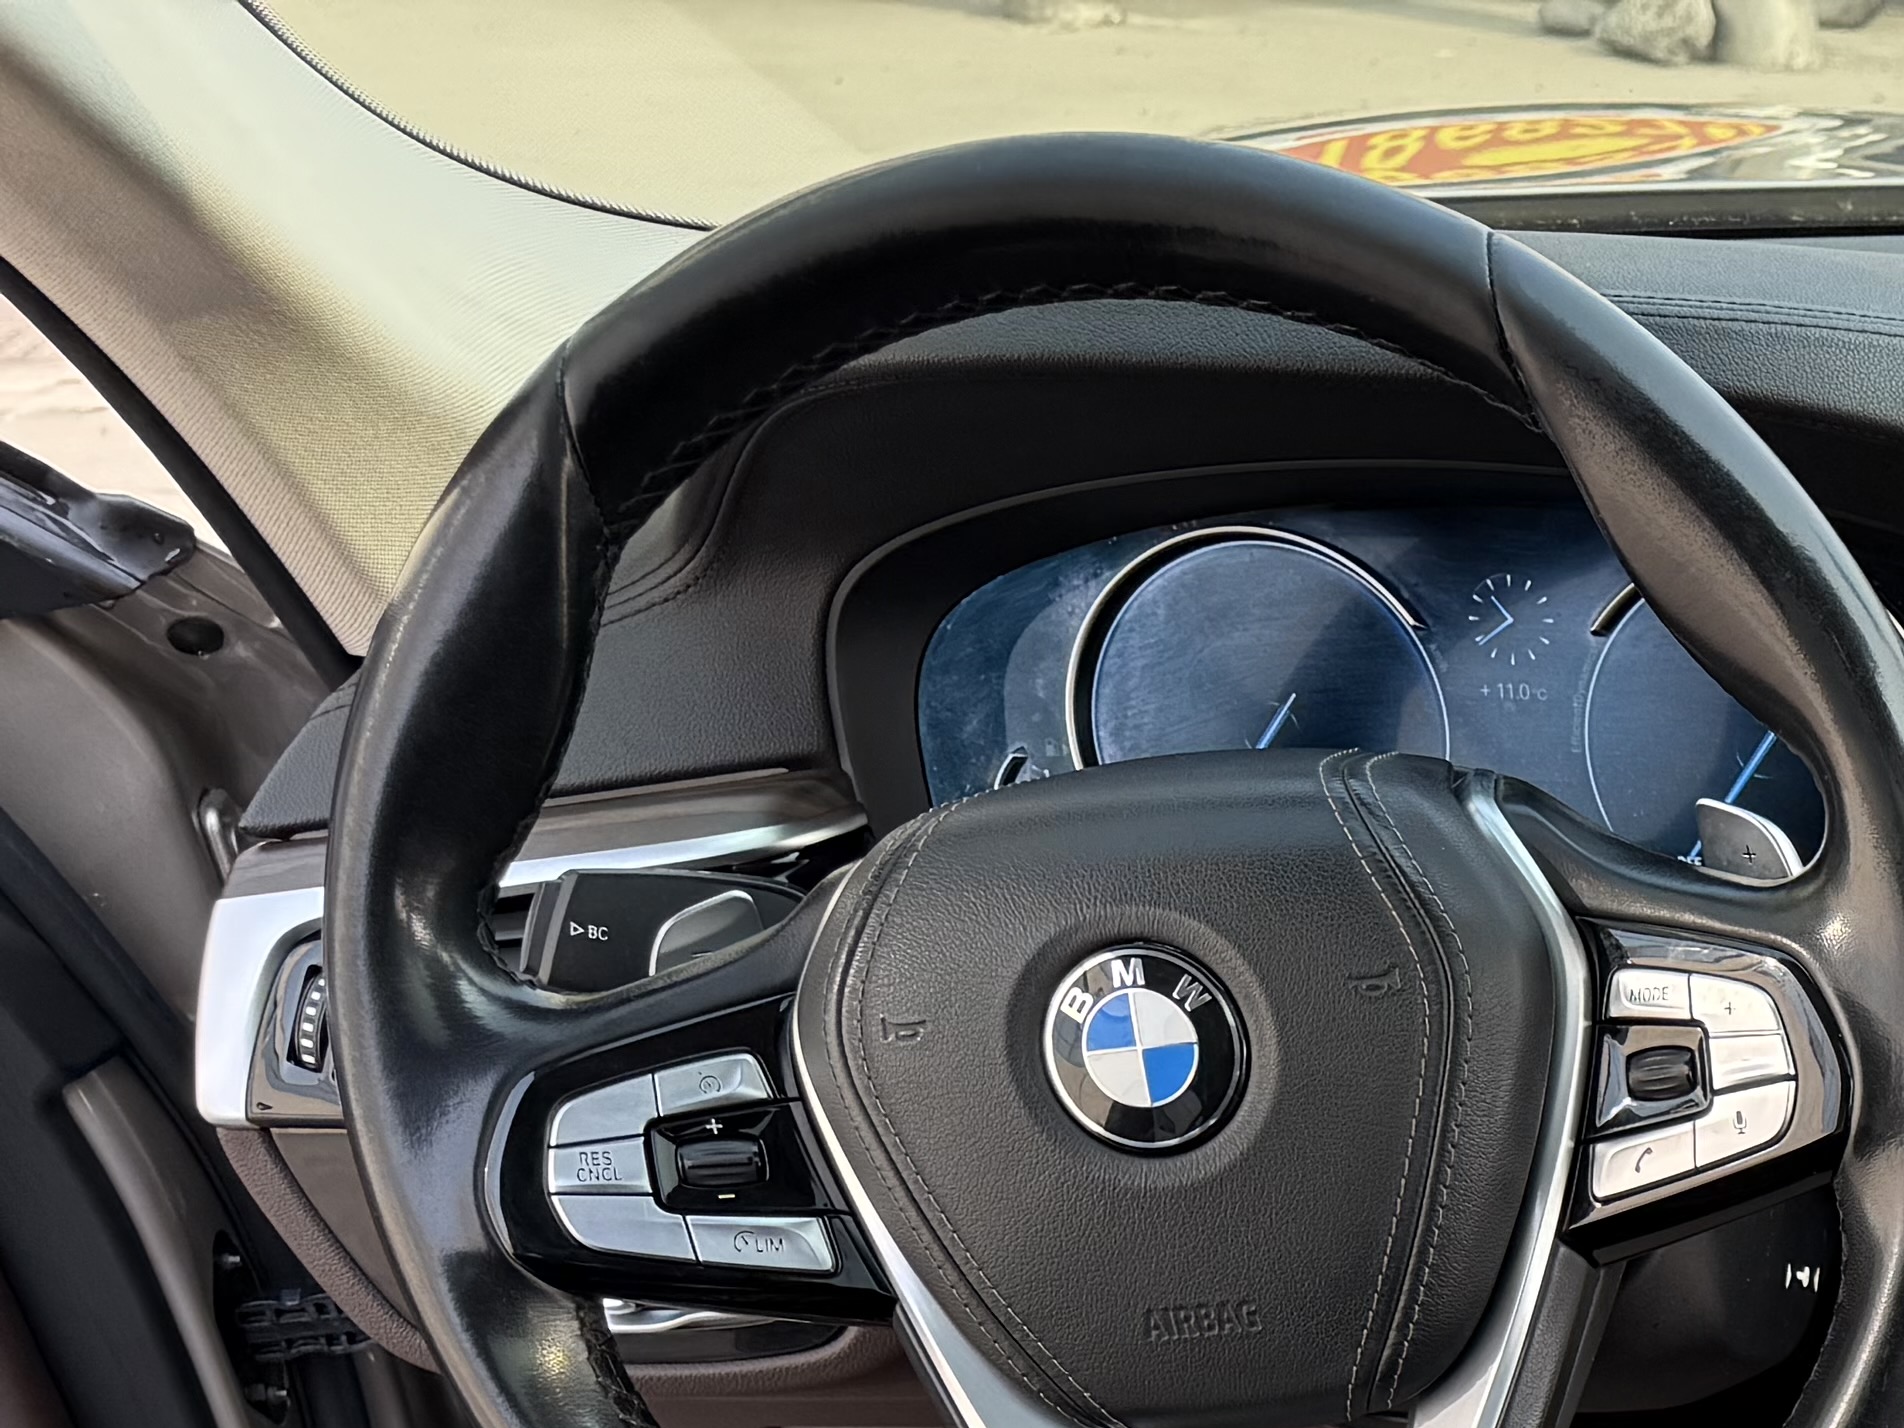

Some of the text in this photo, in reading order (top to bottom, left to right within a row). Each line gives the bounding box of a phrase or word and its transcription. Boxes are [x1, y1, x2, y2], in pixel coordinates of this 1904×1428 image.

[588, 924, 609, 942] BC
[1060, 956, 1214, 1024] BMW
[1628, 984, 1671, 1003] MODE
[579, 1150, 613, 1167] RES
[576, 1167, 623, 1183] CNCL
[755, 1237, 785, 1253] LIM
[1144, 1303, 1264, 1343] AIRBAG
